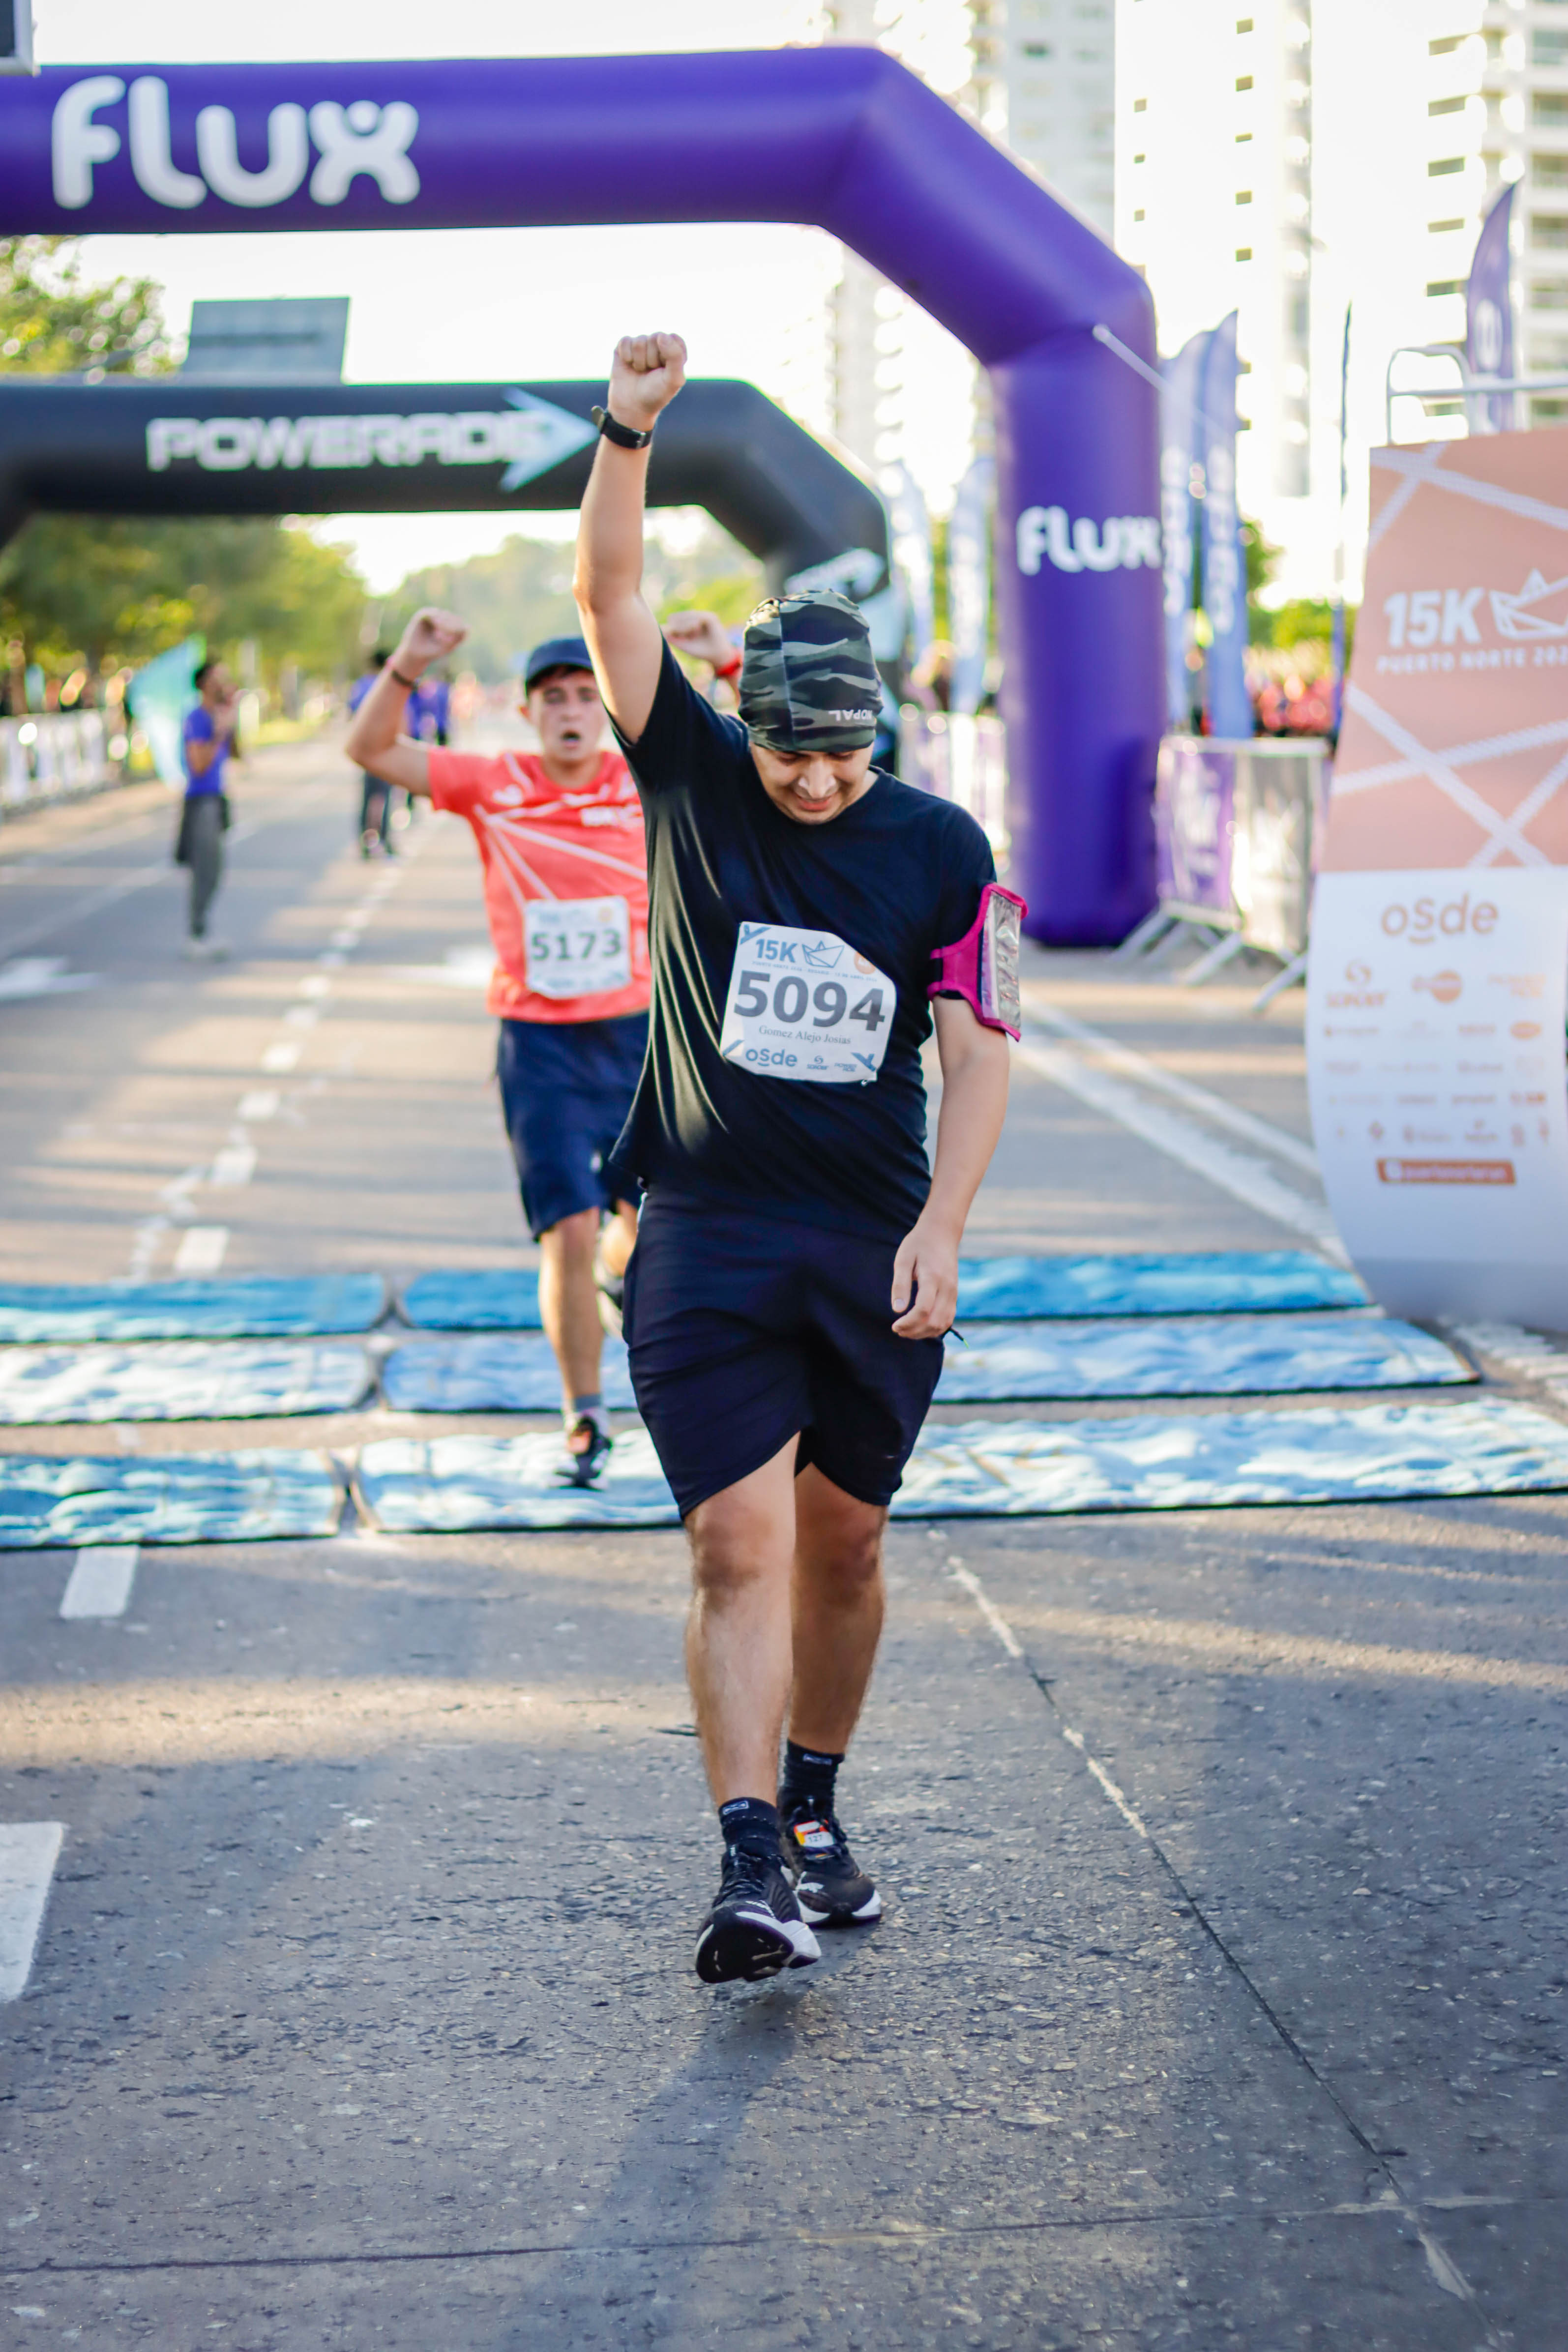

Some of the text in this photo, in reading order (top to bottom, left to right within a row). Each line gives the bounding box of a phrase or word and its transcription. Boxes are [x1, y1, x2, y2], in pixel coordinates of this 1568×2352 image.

[1383, 587, 1485, 649] 15K
[1376, 651, 1455, 675] PUERTO
[1460, 647, 1525, 670] NORTE
[1381, 891, 1499, 938] osde
[531, 929, 622, 961] 5173
[755, 938, 798, 963] 15K
[734, 970, 886, 1031] 5094
[759, 1025, 851, 1044] Gomez Alejo Josias
[745, 1048, 798, 1067] osde
